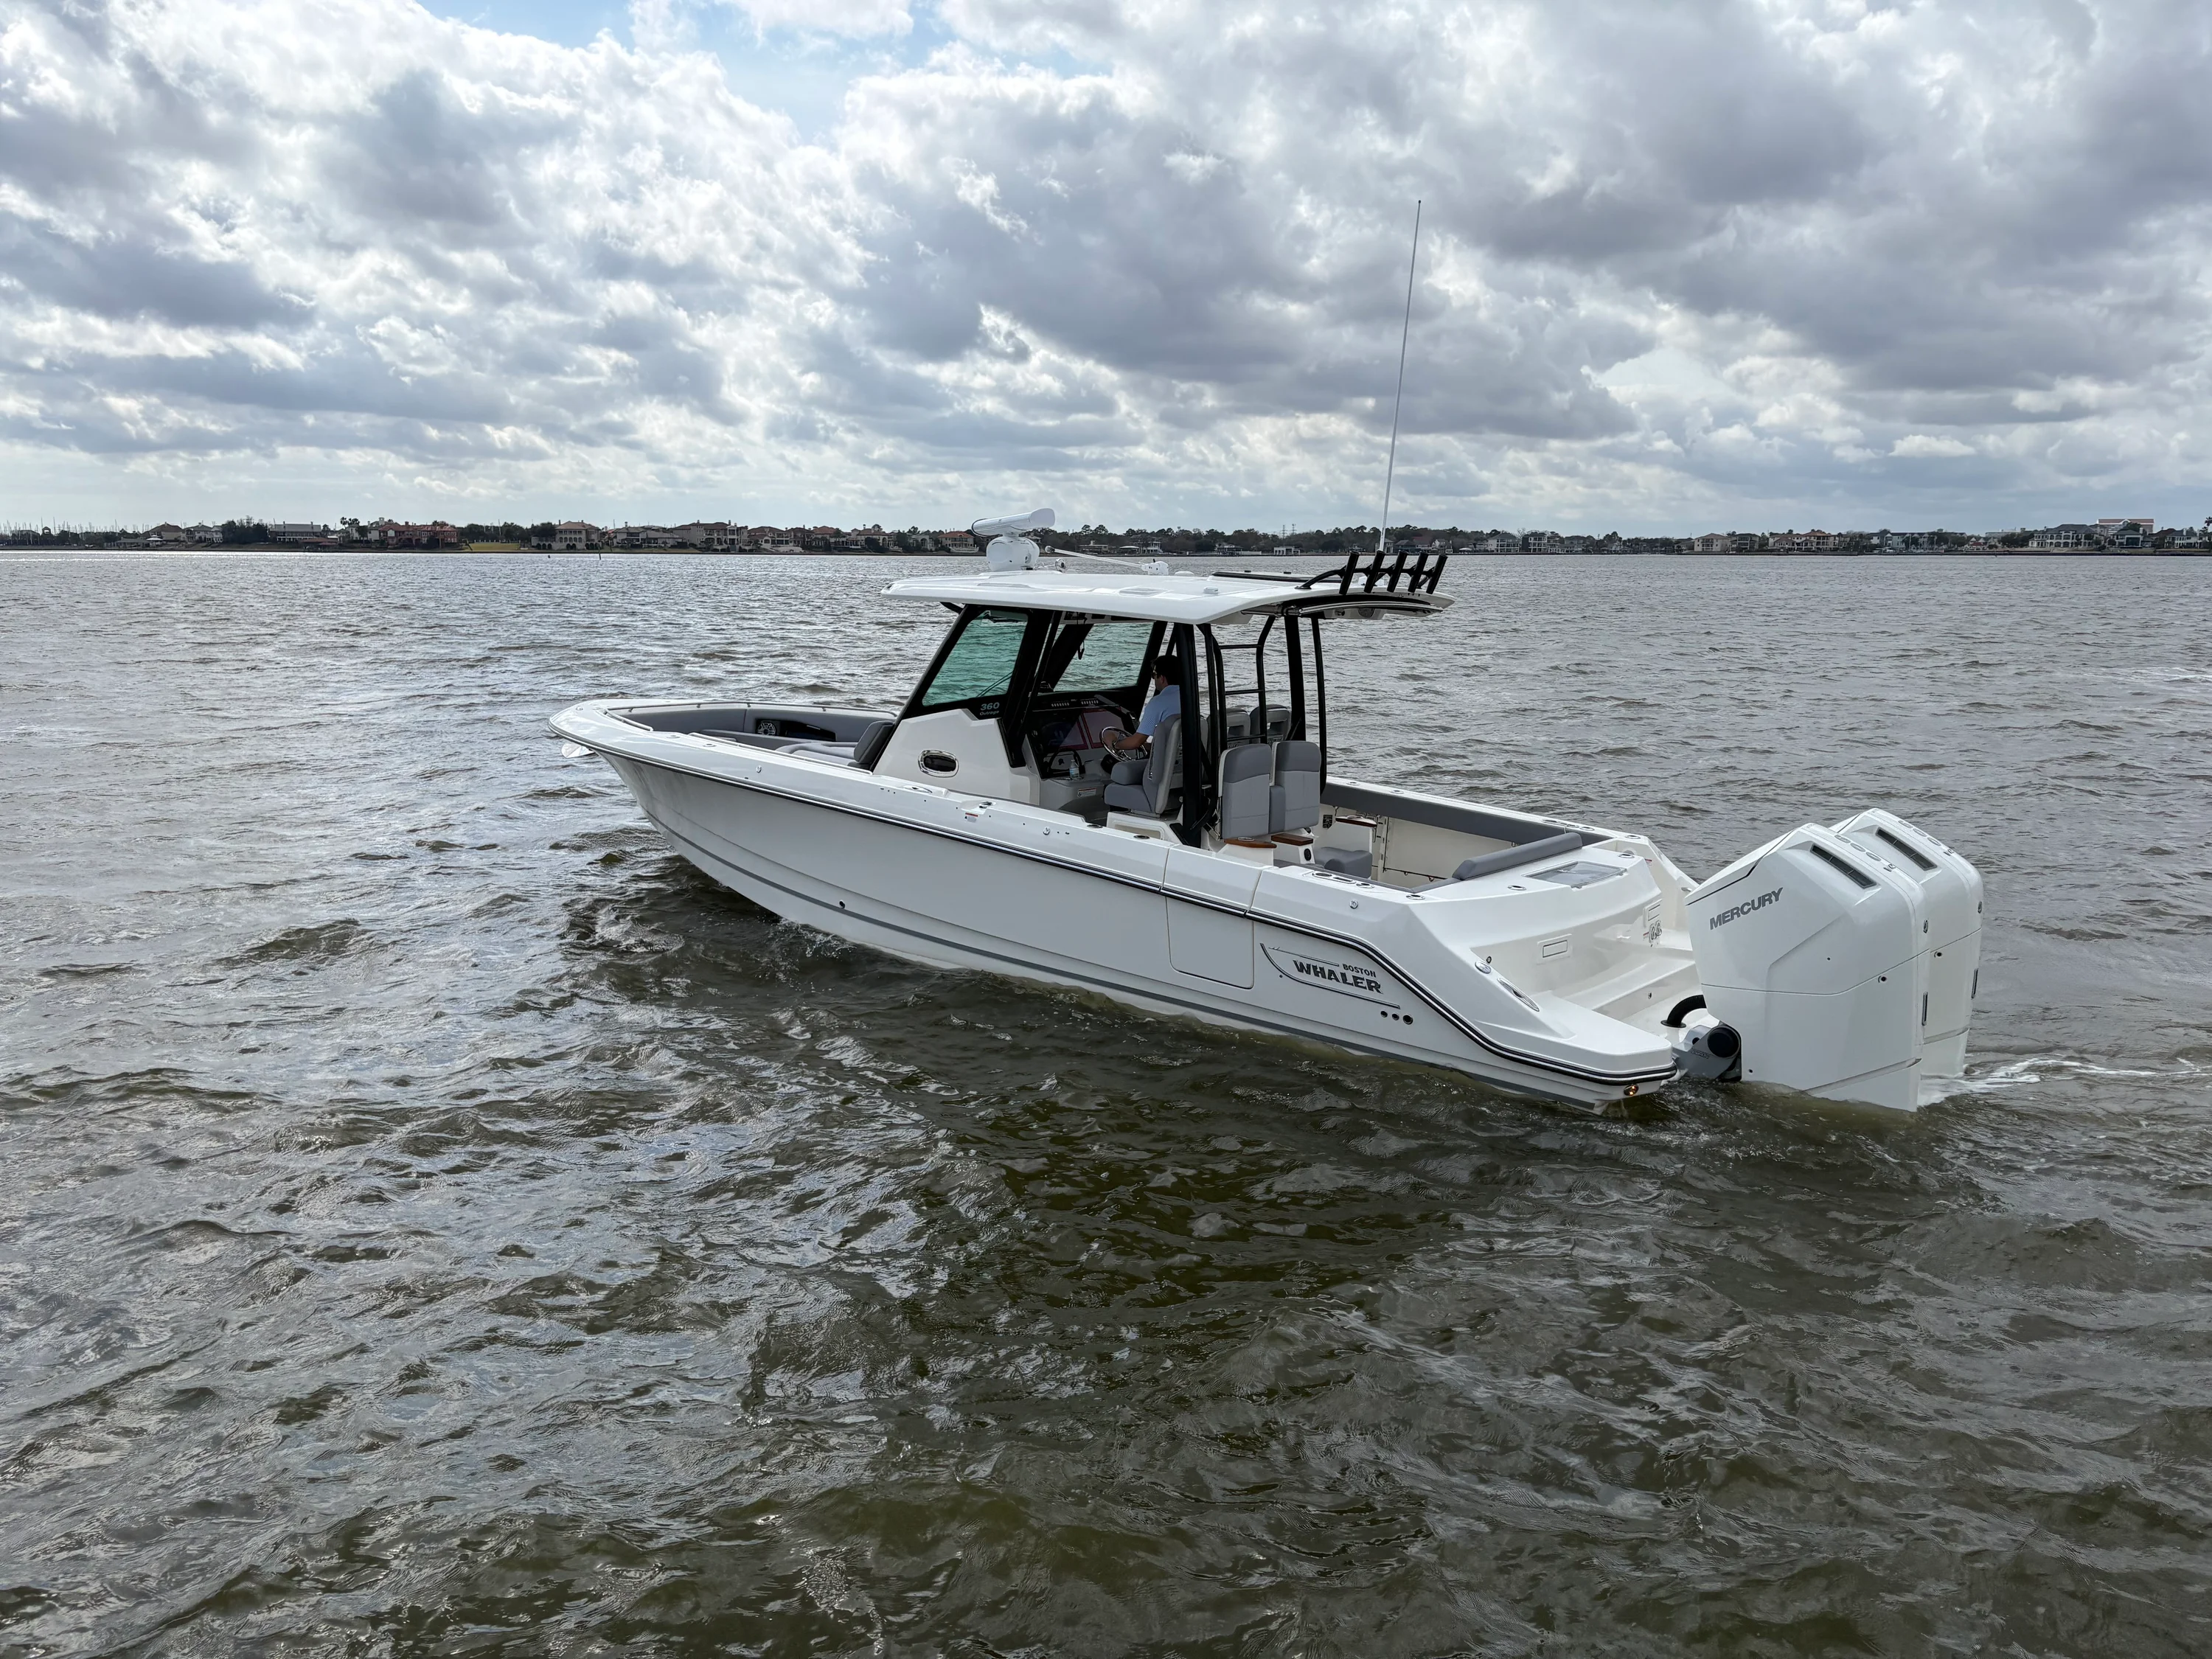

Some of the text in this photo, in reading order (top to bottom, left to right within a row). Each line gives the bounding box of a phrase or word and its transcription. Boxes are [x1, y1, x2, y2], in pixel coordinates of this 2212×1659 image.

[980, 702, 1000, 711] 360
[1834, 834, 1881, 862] 600
[1709, 887, 1784, 931] MERCURY
[1293, 959, 1383, 995] WHALER
[1342, 963, 1377, 978] BOSTON
